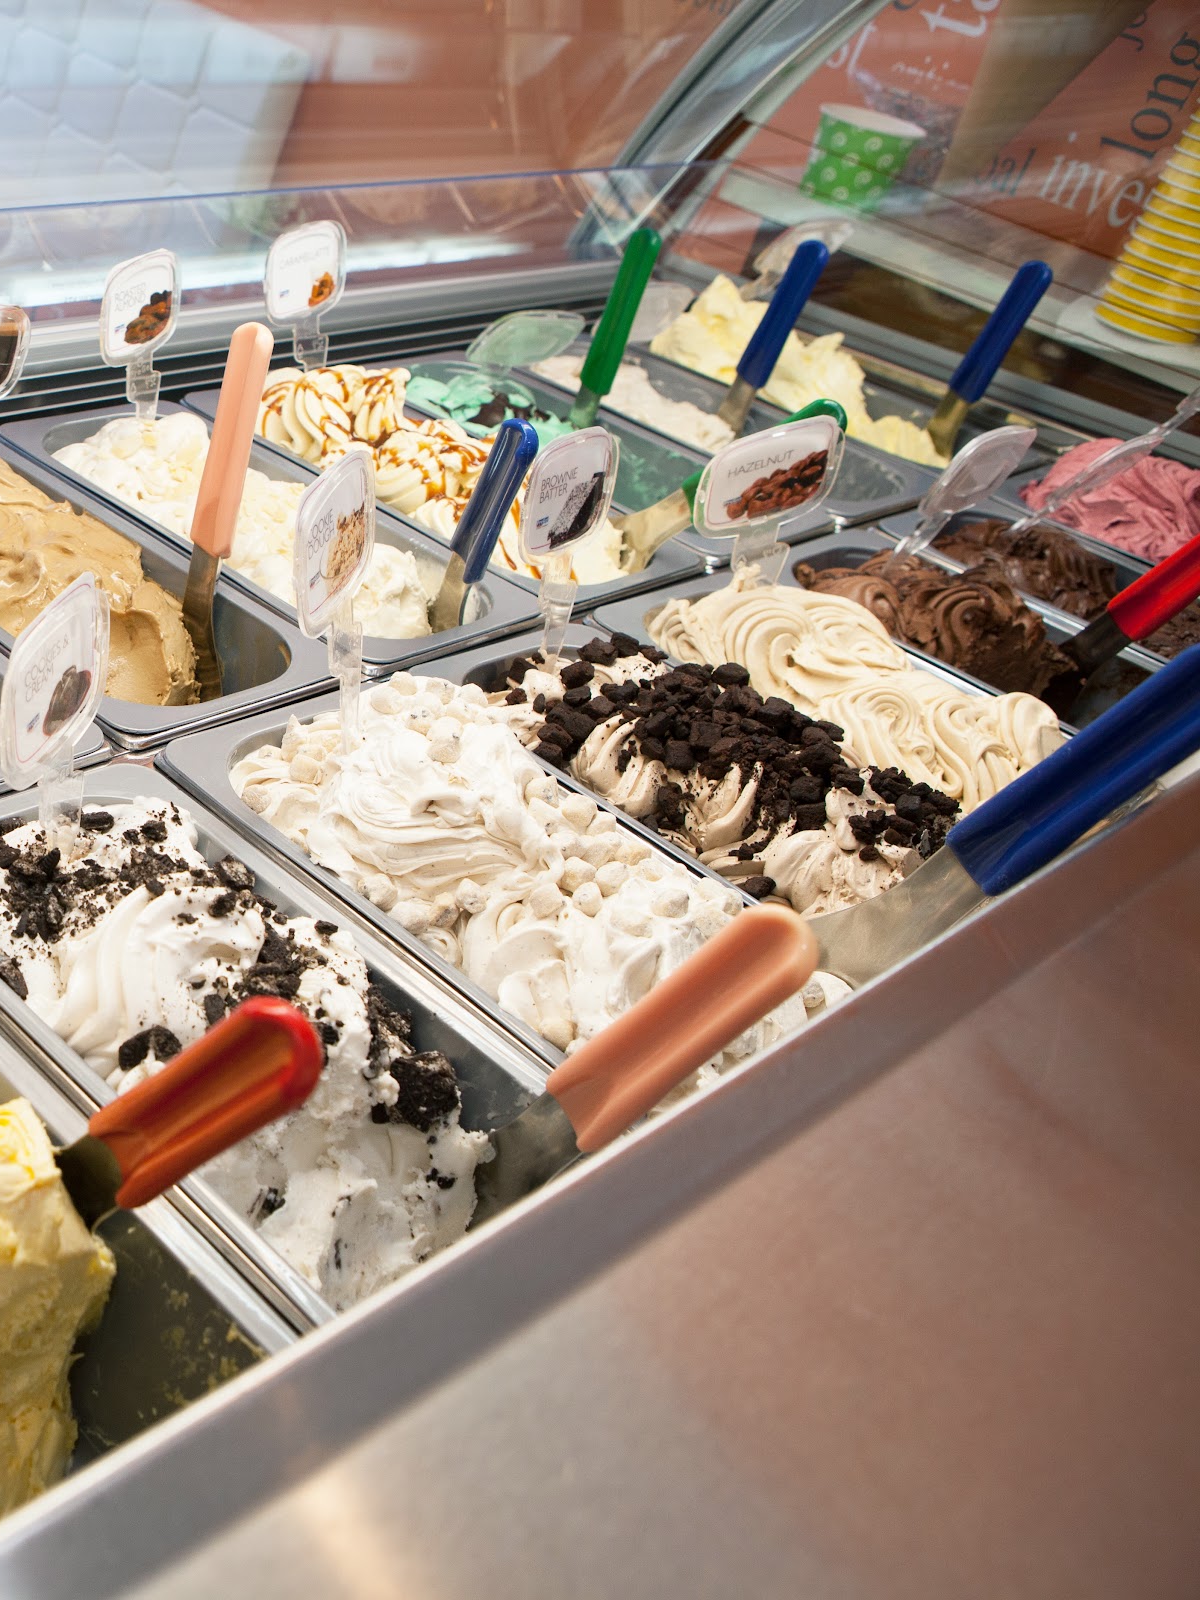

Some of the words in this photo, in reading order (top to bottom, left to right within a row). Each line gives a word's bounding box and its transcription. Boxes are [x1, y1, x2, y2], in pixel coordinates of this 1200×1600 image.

[1101, 32, 1200, 160] long
[1039, 131, 1150, 230] inve
[540, 467, 578, 491] BROWNIE
[727, 449, 794, 478] HAZELNUT
[539, 483, 568, 503] BATTER
[25, 640, 61, 687] COOKIES
[26, 663, 54, 702] CREAM
